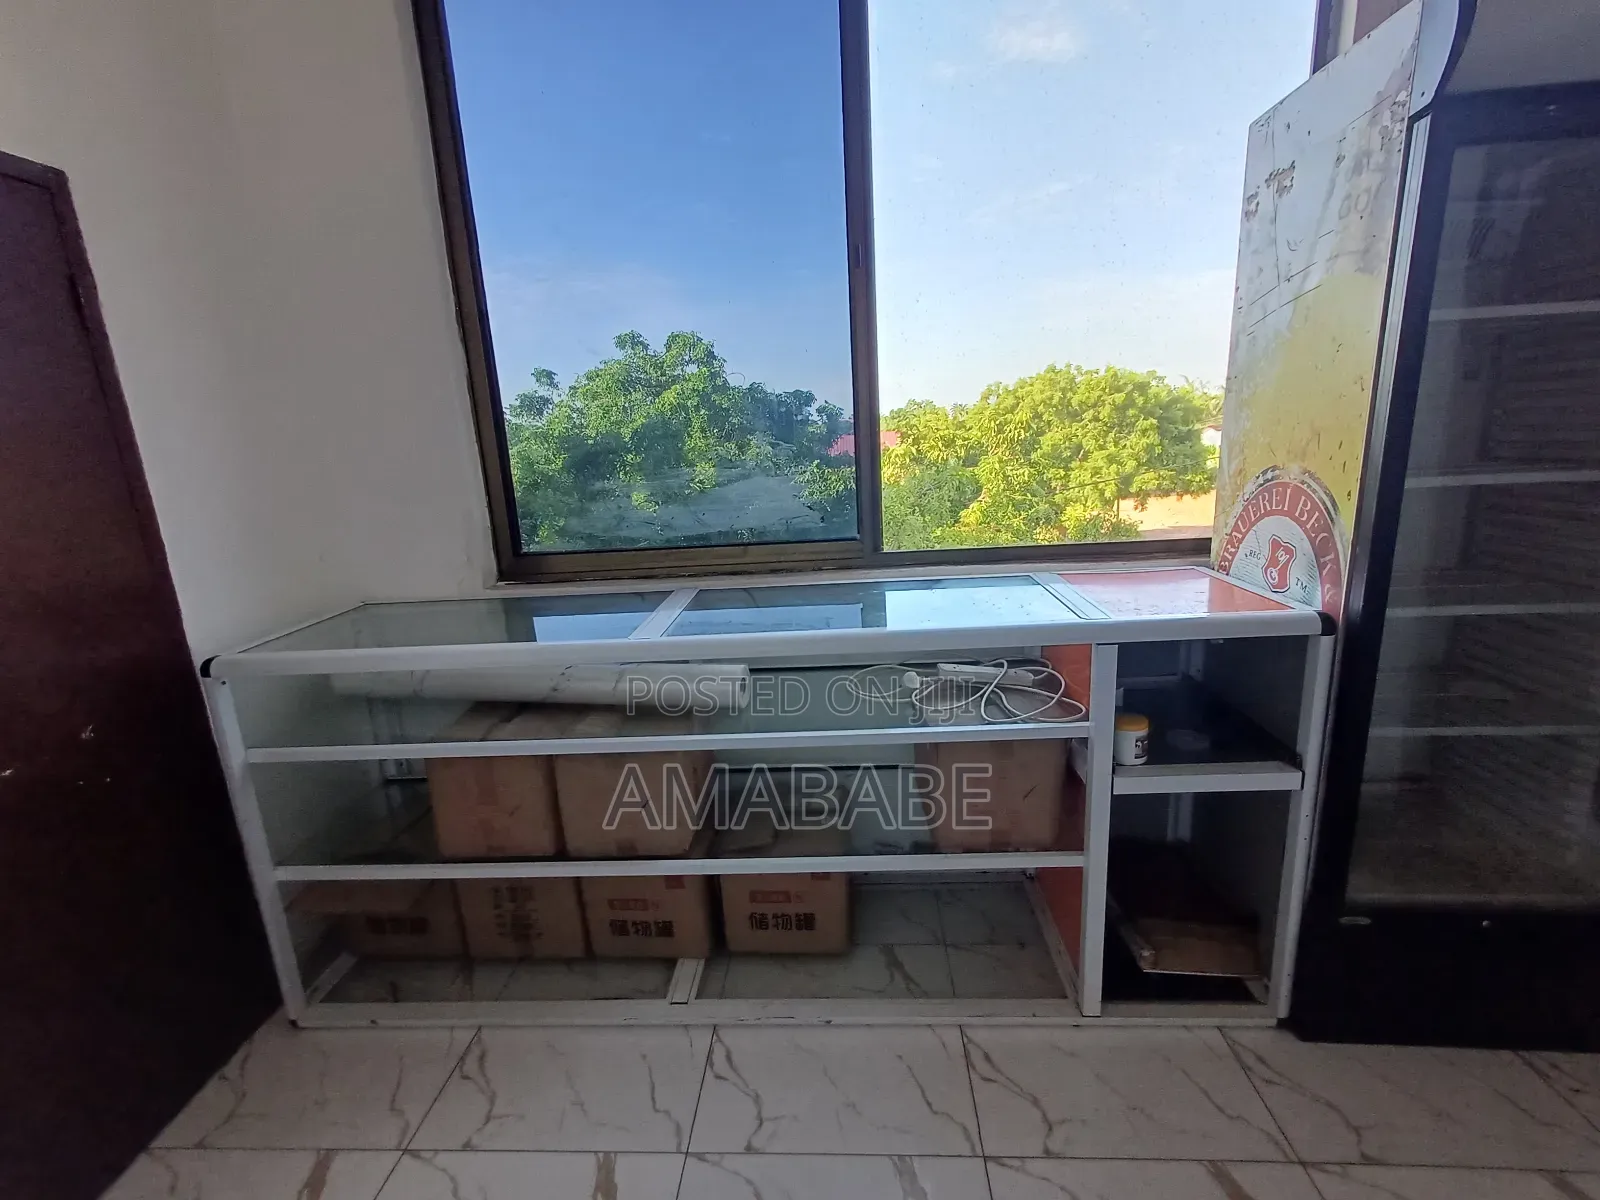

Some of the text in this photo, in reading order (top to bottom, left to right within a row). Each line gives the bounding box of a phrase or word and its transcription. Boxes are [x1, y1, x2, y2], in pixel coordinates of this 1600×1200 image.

[1219, 485, 1293, 574] BRAUEREI
[1295, 496, 1337, 577] BECK
[608, 919, 675, 938] 储物罐
[748, 912, 816, 933] 储物罐
